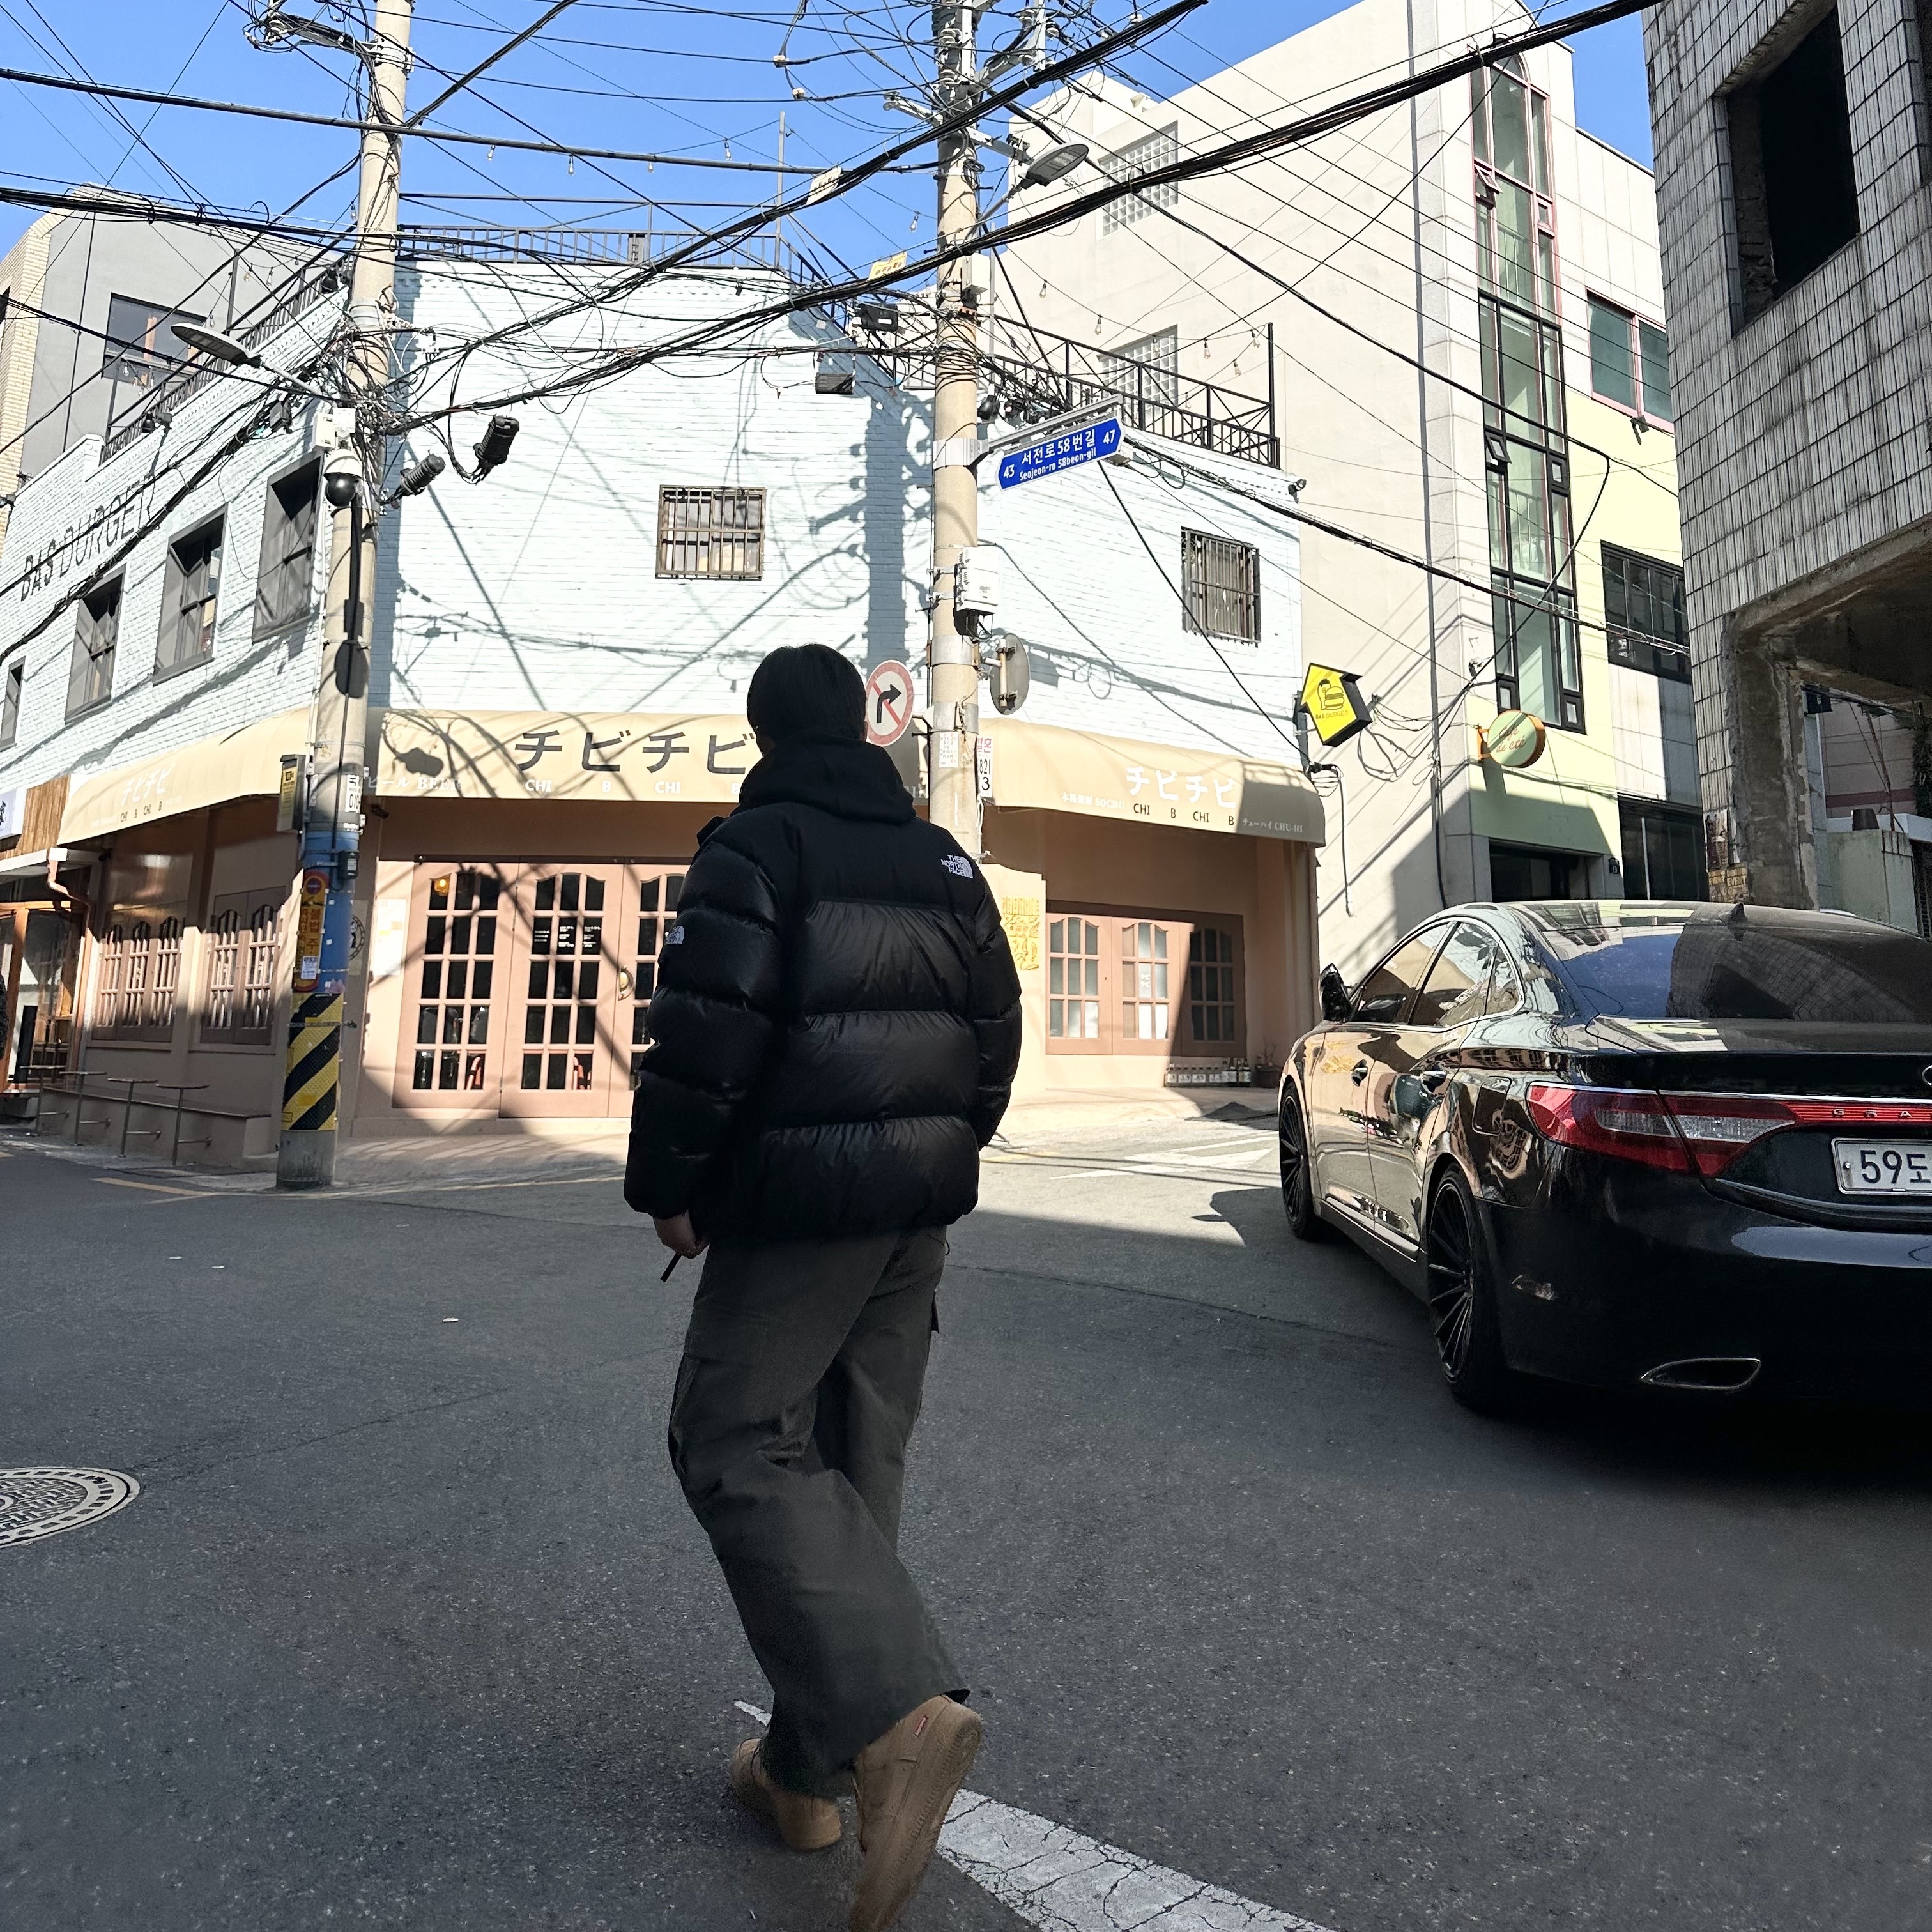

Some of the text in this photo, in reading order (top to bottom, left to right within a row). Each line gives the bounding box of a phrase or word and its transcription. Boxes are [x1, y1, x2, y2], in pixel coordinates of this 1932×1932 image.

[1003, 429, 1116, 479] 43 서전로58번길 47
[1020, 447, 1096, 481] Seojeon-ro 58beon-gil
[514, 730, 755, 775] チビチビ
[525, 779, 552, 792] CHI
[602, 780, 612, 793] B
[655, 781, 681, 794] CHI
[1126, 766, 1237, 809] チビチビ
[1133, 803, 1234, 825] CHI B CHI B
[940, 859, 962, 870] NORTH
[947, 854, 962, 862] THE
[948, 867, 965, 877] FACE
[1860, 1149, 1931, 1184] 59도
